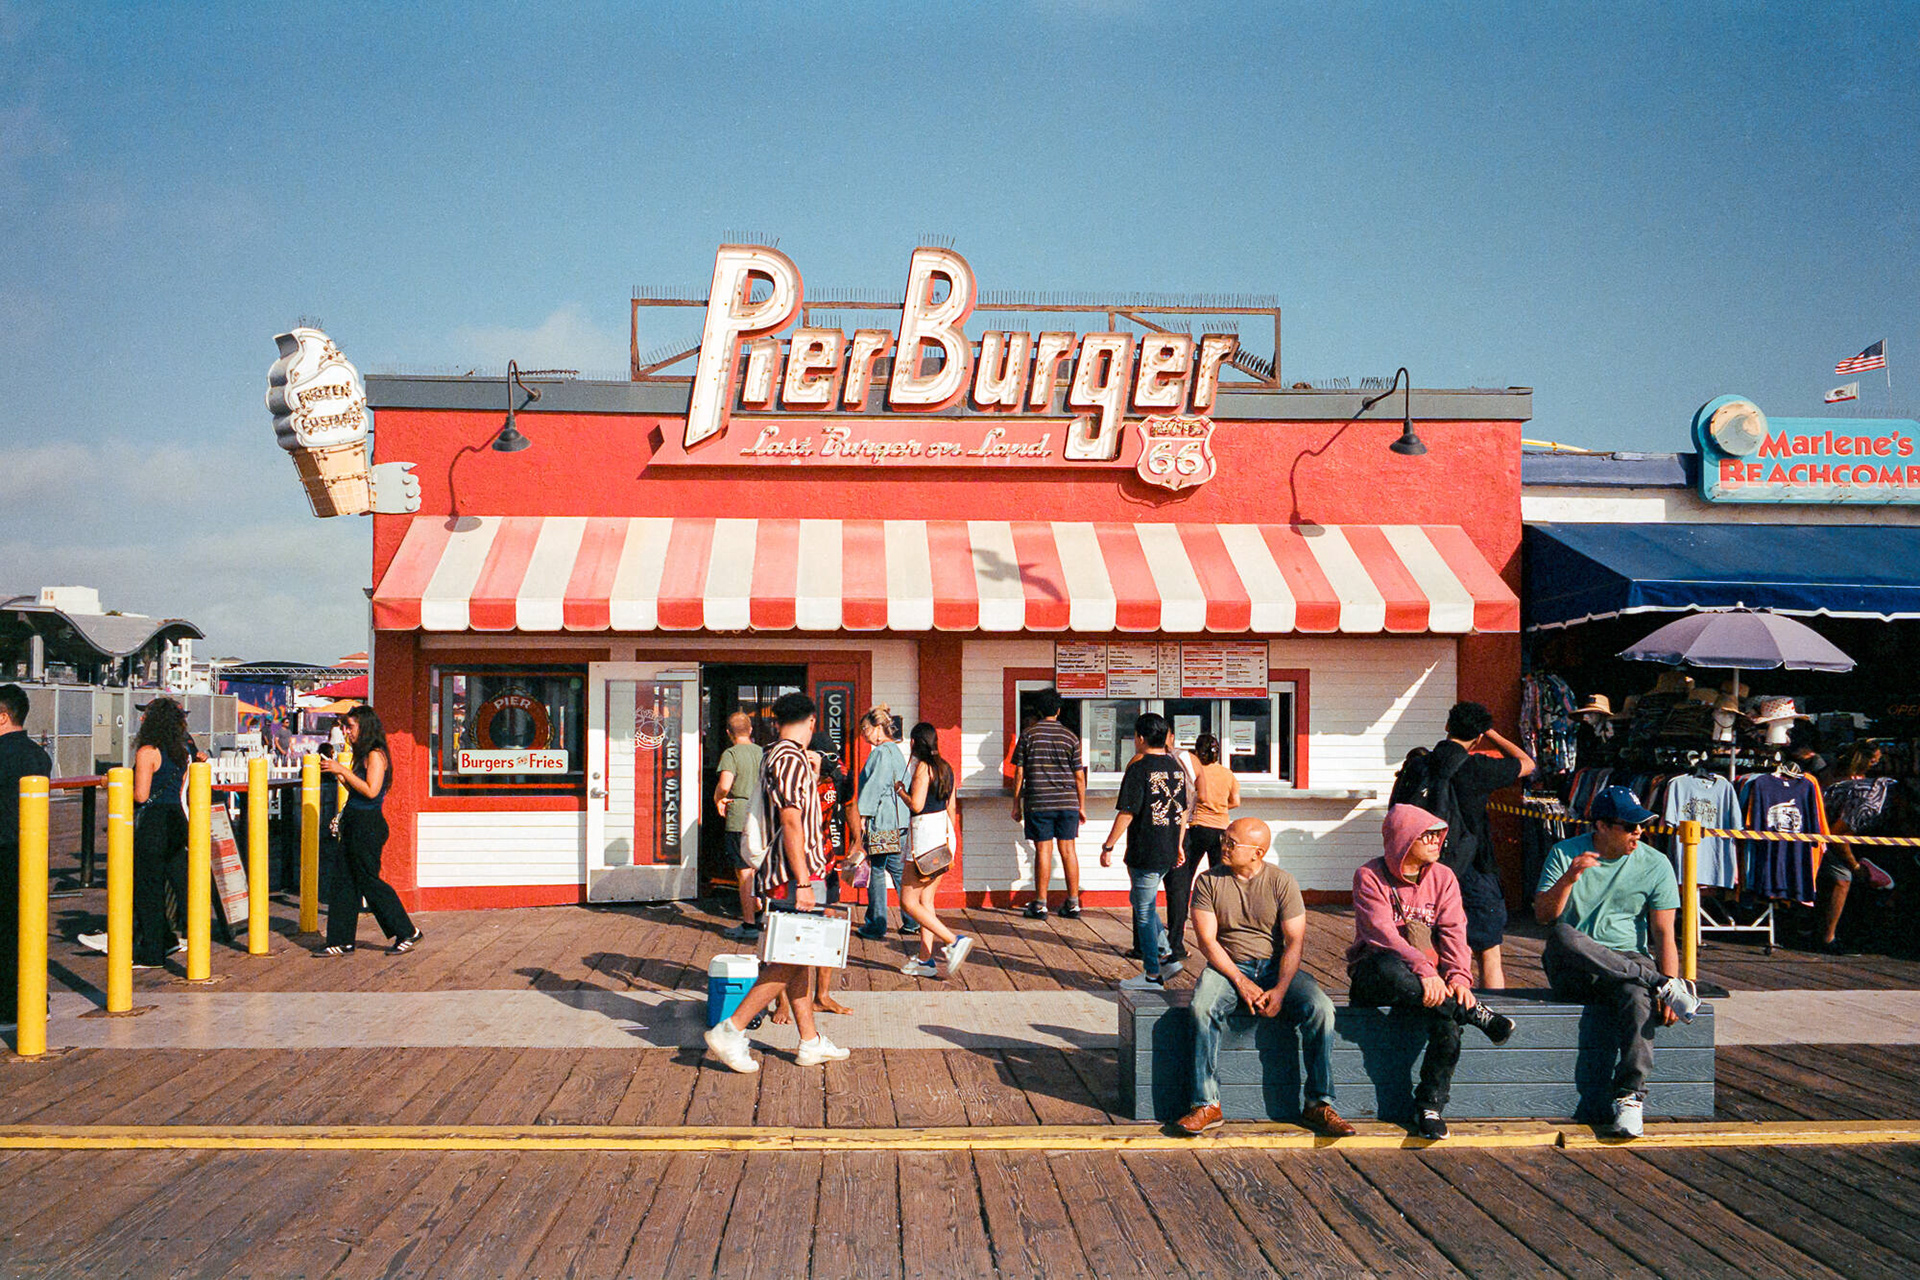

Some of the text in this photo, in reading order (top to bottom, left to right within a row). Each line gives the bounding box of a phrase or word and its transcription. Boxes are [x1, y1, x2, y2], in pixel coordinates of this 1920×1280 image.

[740, 425, 1052, 464] Last Burger on Land
[1148, 441, 1204, 475] 66
[1758, 430, 1914, 458] Marlene's
[493, 696, 531, 711] PIER
[461, 753, 514, 772] Burgers
[529, 753, 563, 768] Fries
[665, 778, 680, 846] SHAKES
